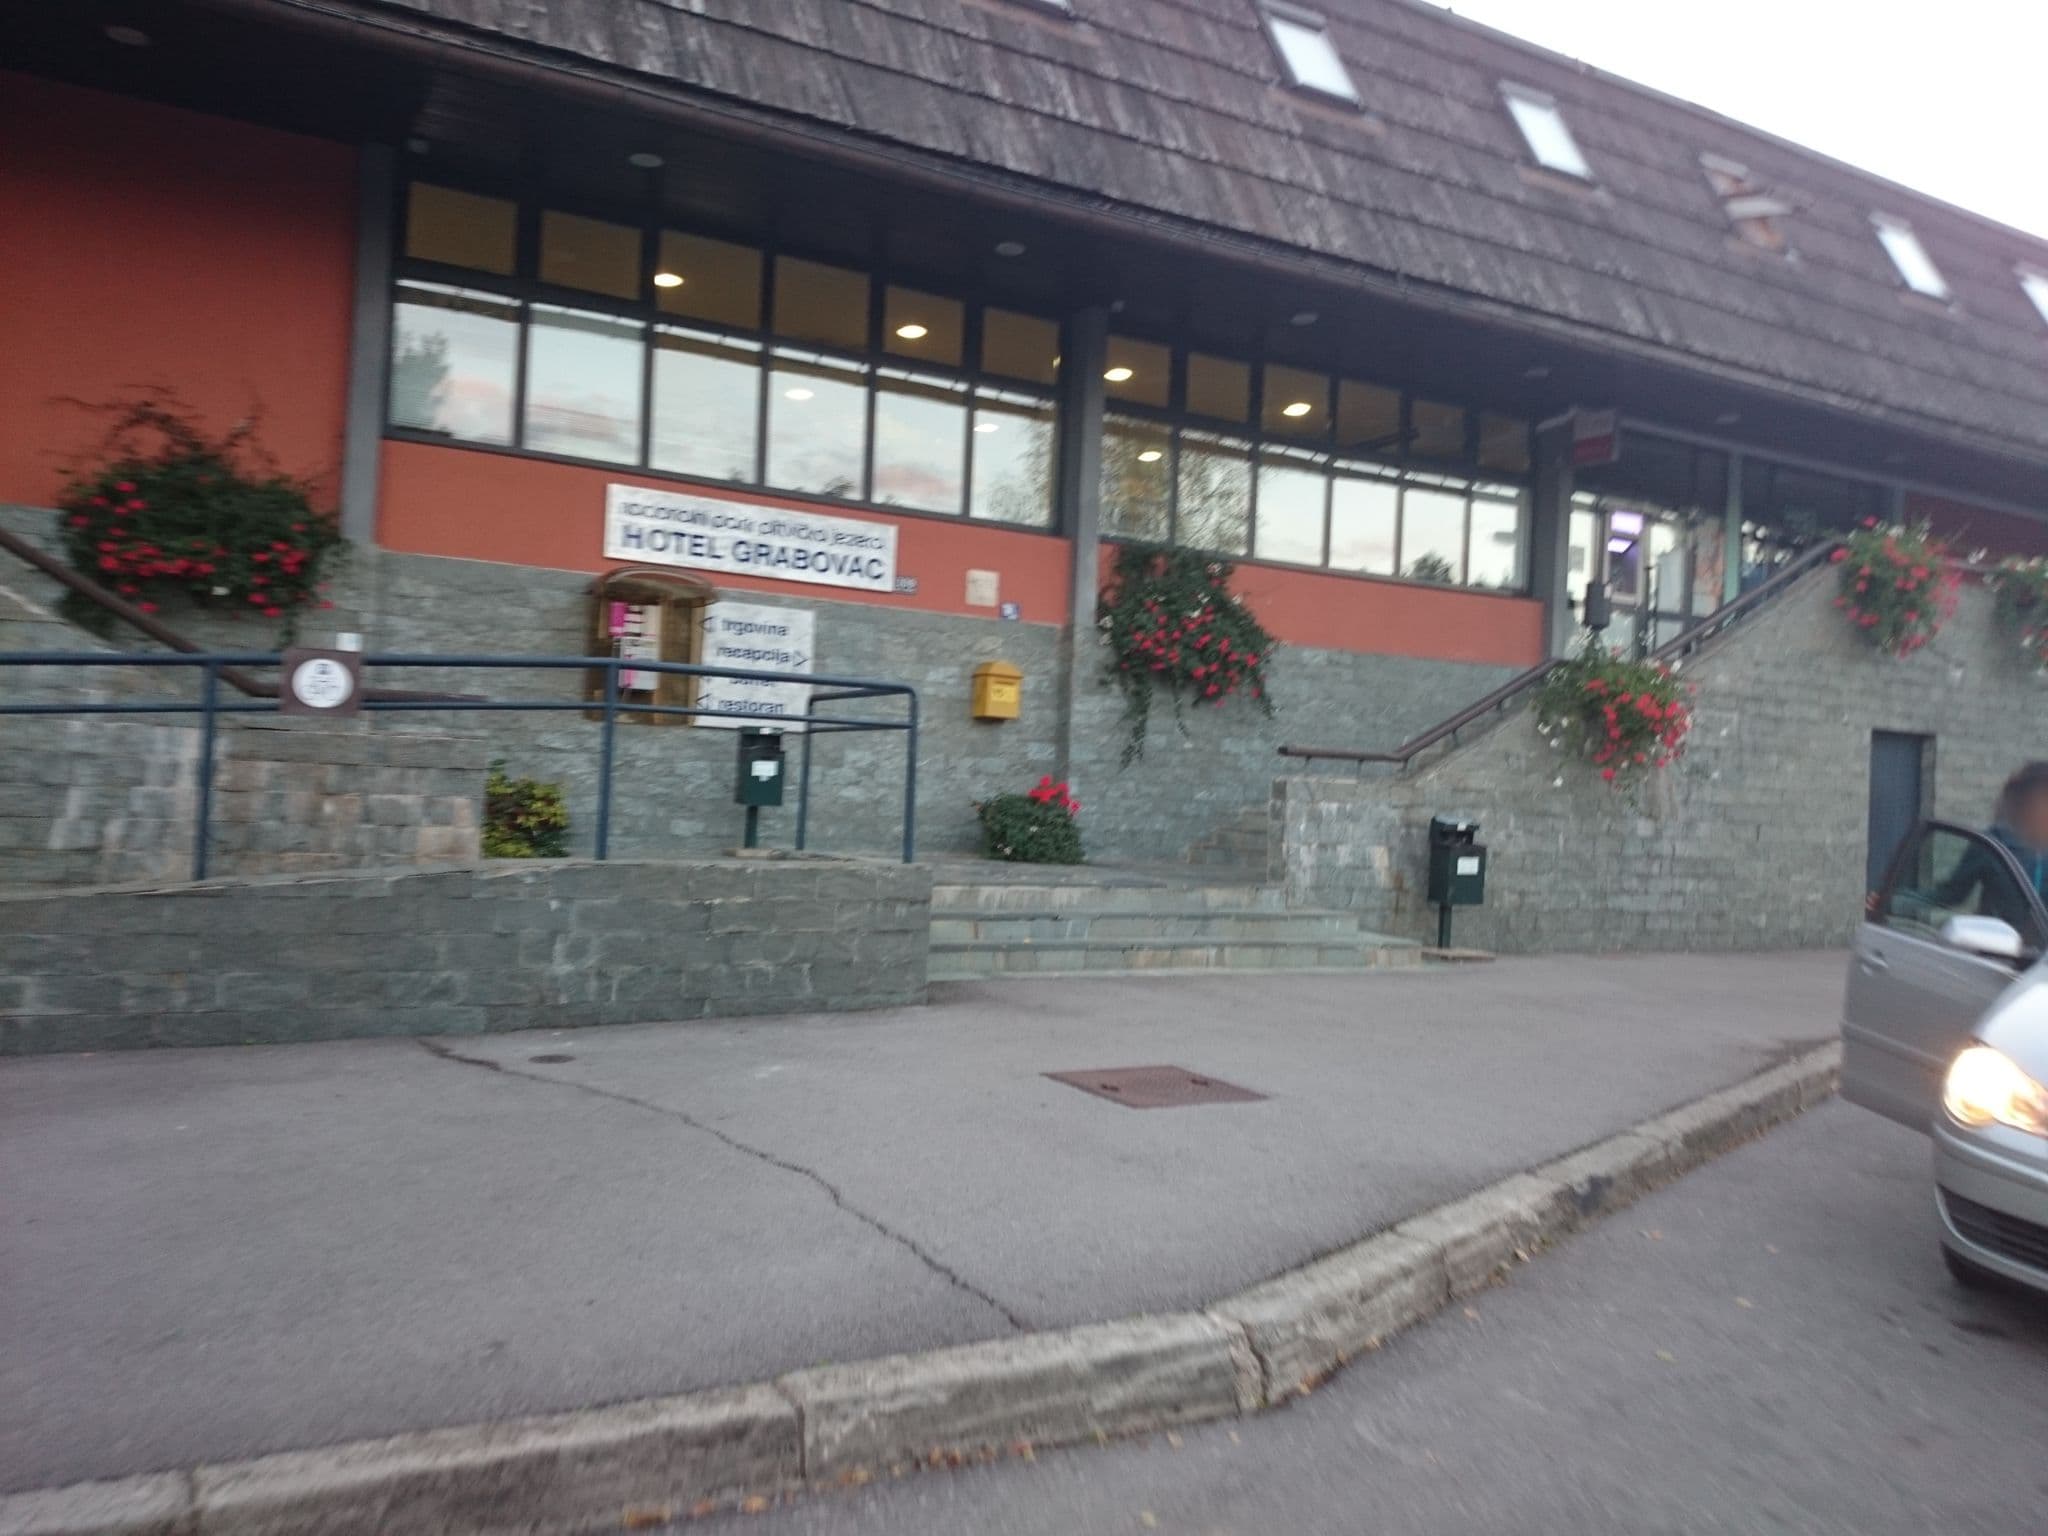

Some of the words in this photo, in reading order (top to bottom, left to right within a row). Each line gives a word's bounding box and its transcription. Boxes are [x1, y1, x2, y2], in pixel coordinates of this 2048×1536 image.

[621, 525, 723, 560] HOTEL
[731, 540, 885, 580] GRABOVAC
[721, 618, 788, 637] trgovina
[717, 646, 790, 665] recepcija
[719, 699, 784, 713] restoran
